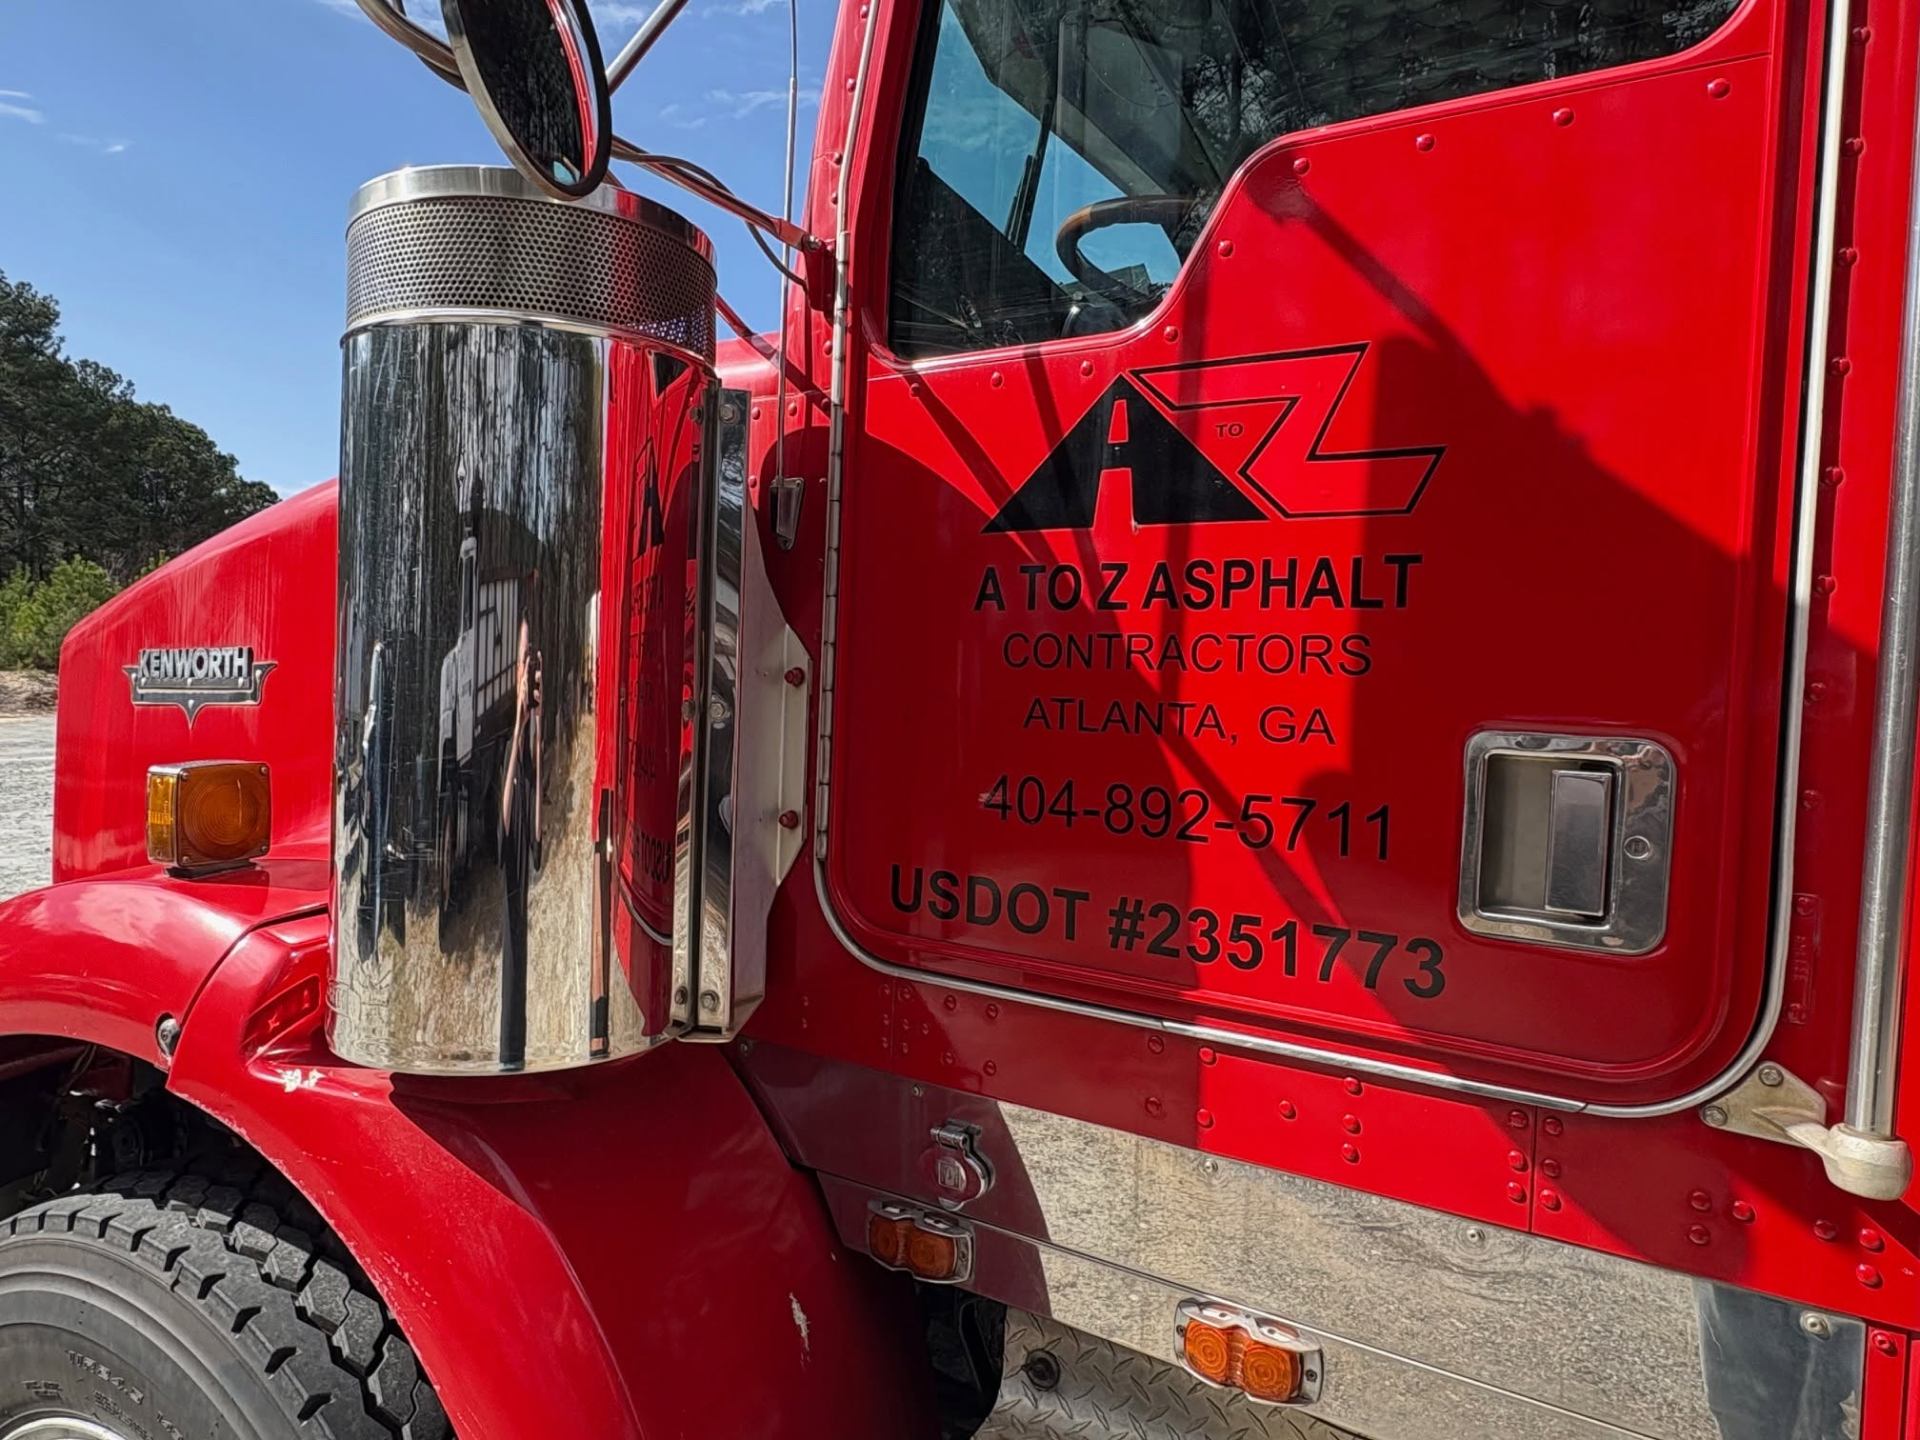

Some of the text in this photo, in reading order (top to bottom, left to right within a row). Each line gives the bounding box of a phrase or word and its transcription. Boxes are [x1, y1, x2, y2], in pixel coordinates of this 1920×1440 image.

[980, 342, 1446, 532] A TO Z
[974, 555, 1422, 611] A TO Z ASPHALT
[138, 647, 248, 678] KENWORTH
[1003, 632, 1373, 676] CONTRACTORS
[1023, 698, 1336, 746] ATLANTA, GA
[982, 776, 1392, 861] 404-892-5711
[890, 866, 1447, 999] USDOT #2351773
